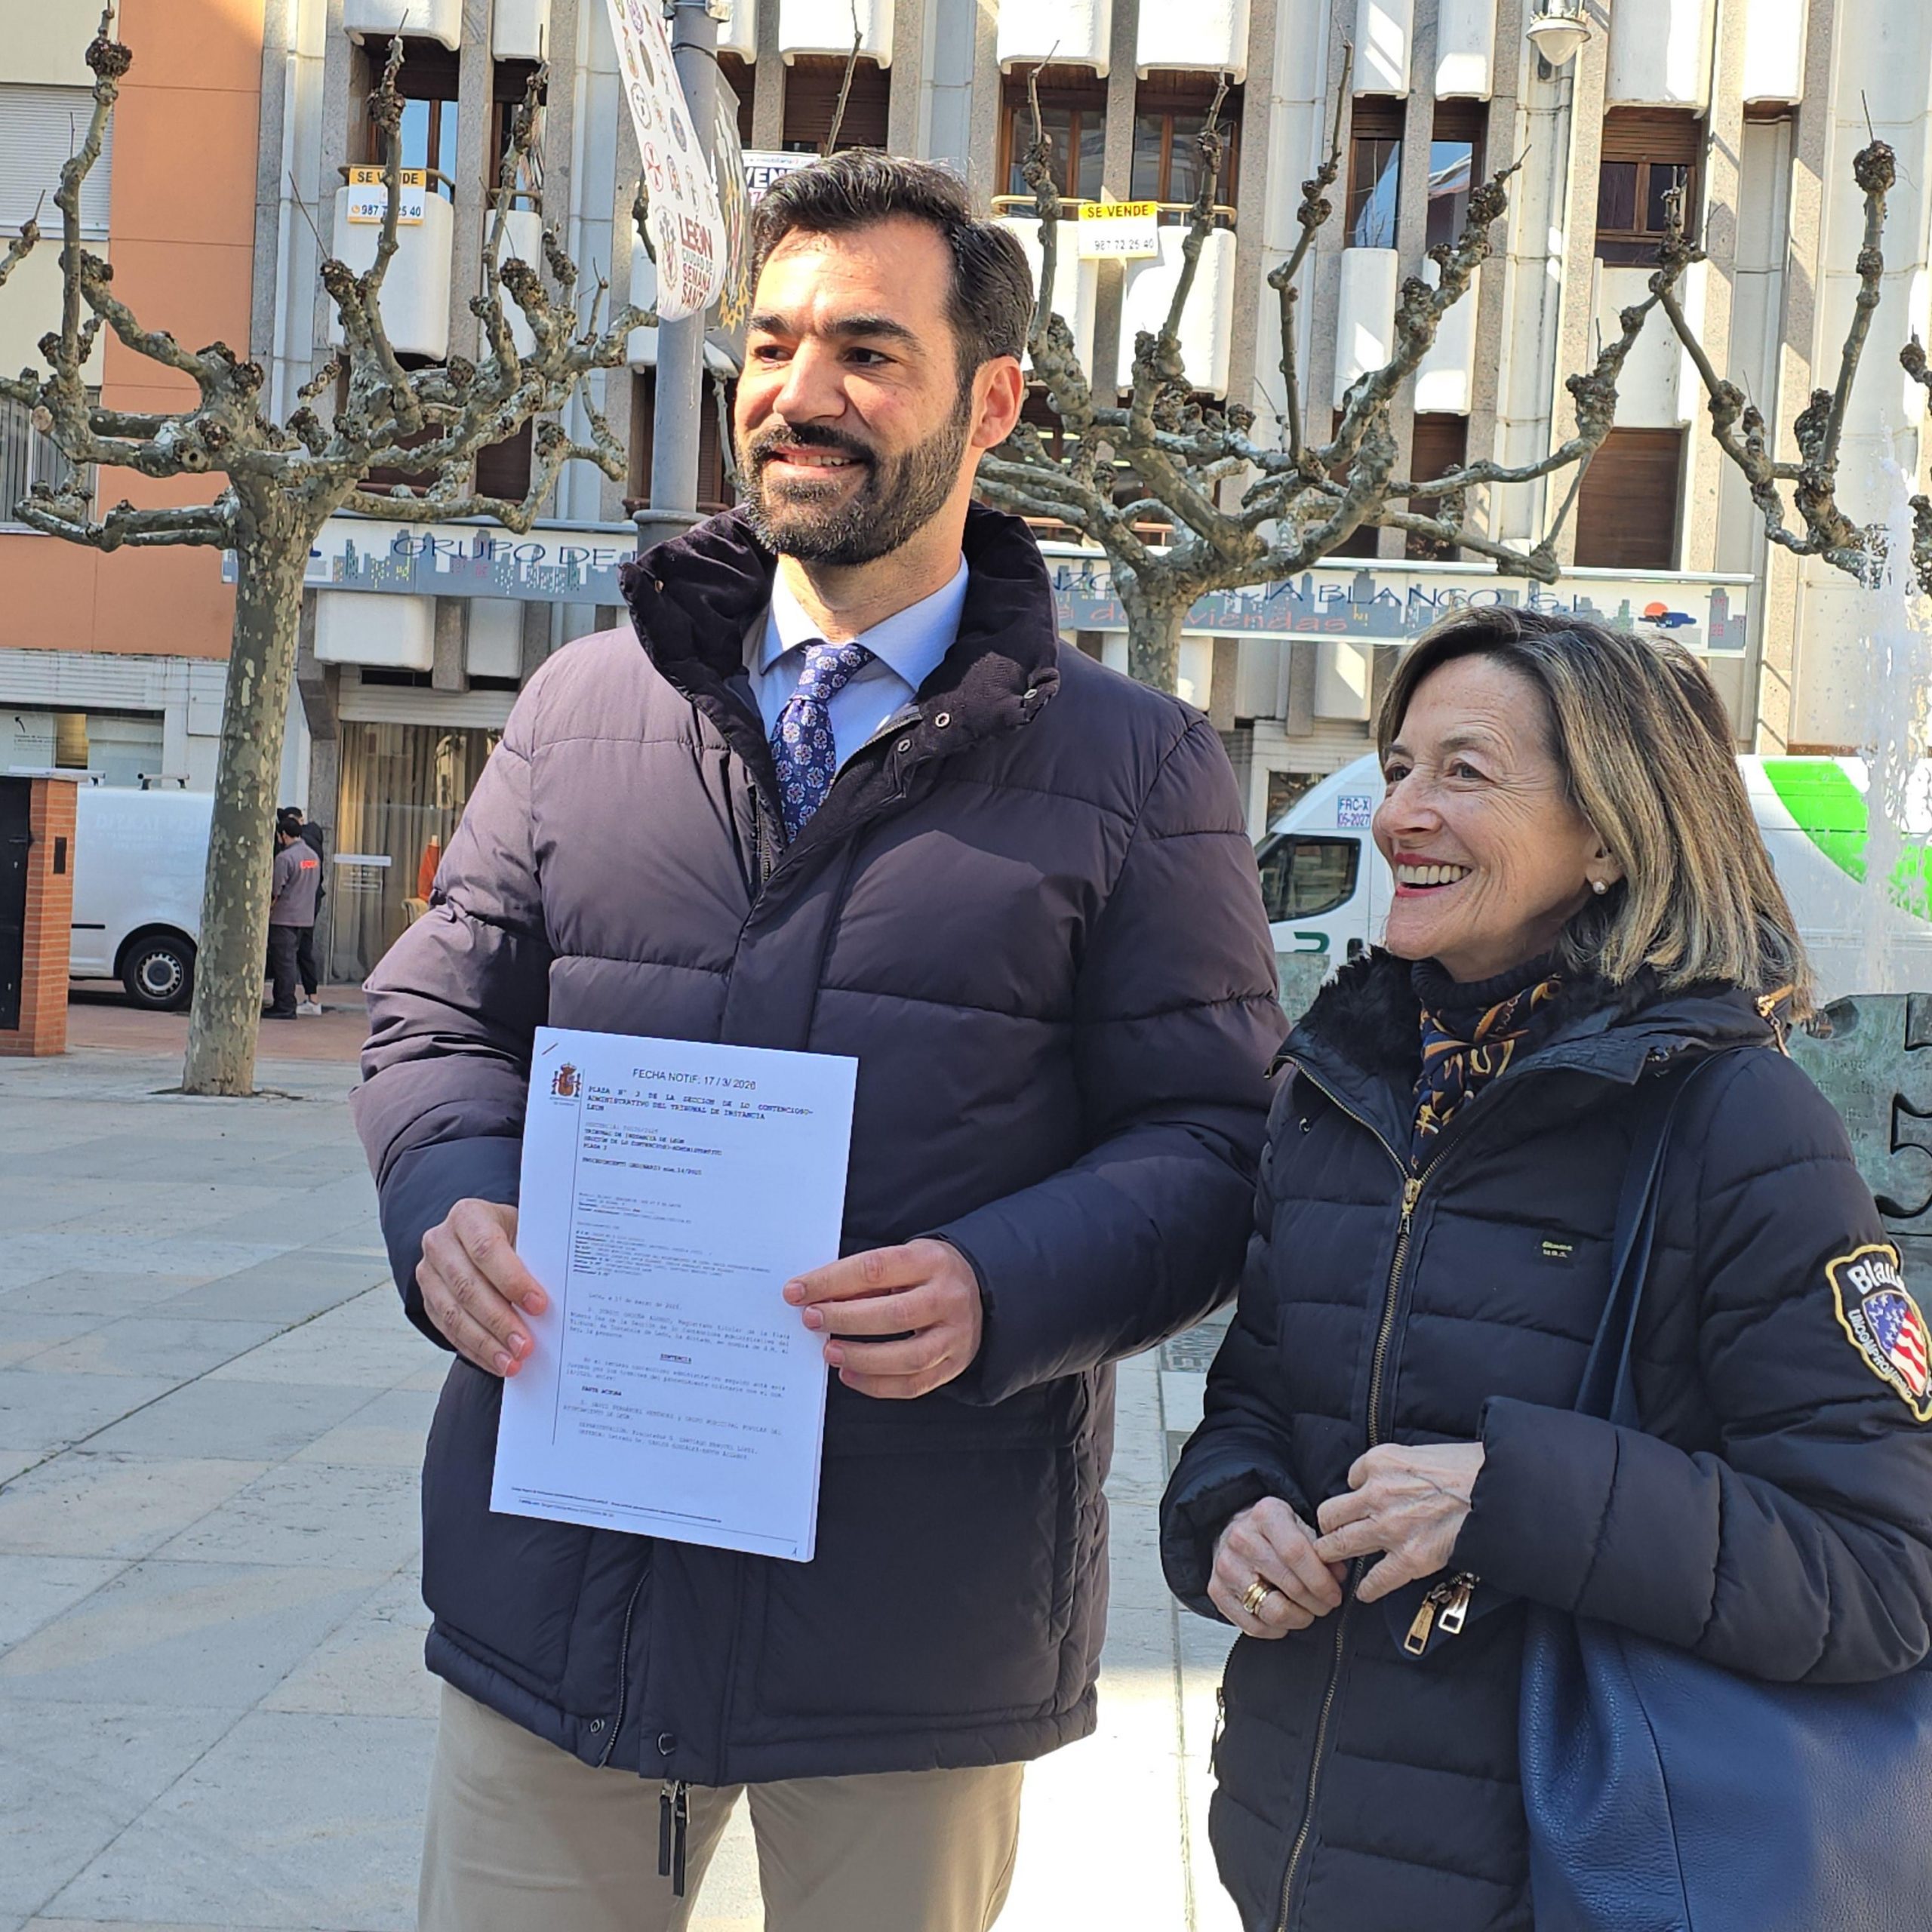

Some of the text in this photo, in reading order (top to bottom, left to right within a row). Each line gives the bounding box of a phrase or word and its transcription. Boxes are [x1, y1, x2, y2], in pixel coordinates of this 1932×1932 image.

[357, 171, 373, 183] SE
[361, 205, 379, 216] 987
[410, 206, 421, 217] 40
[1088, 205, 1149, 218] SE VENDE
[394, 537, 546, 565] GRUPO
[559, 546, 617, 567] DE
[632, 1068, 666, 1081] FECHA
[668, 1072, 700, 1085] NOTIF:
[704, 1076, 715, 1086] 17
